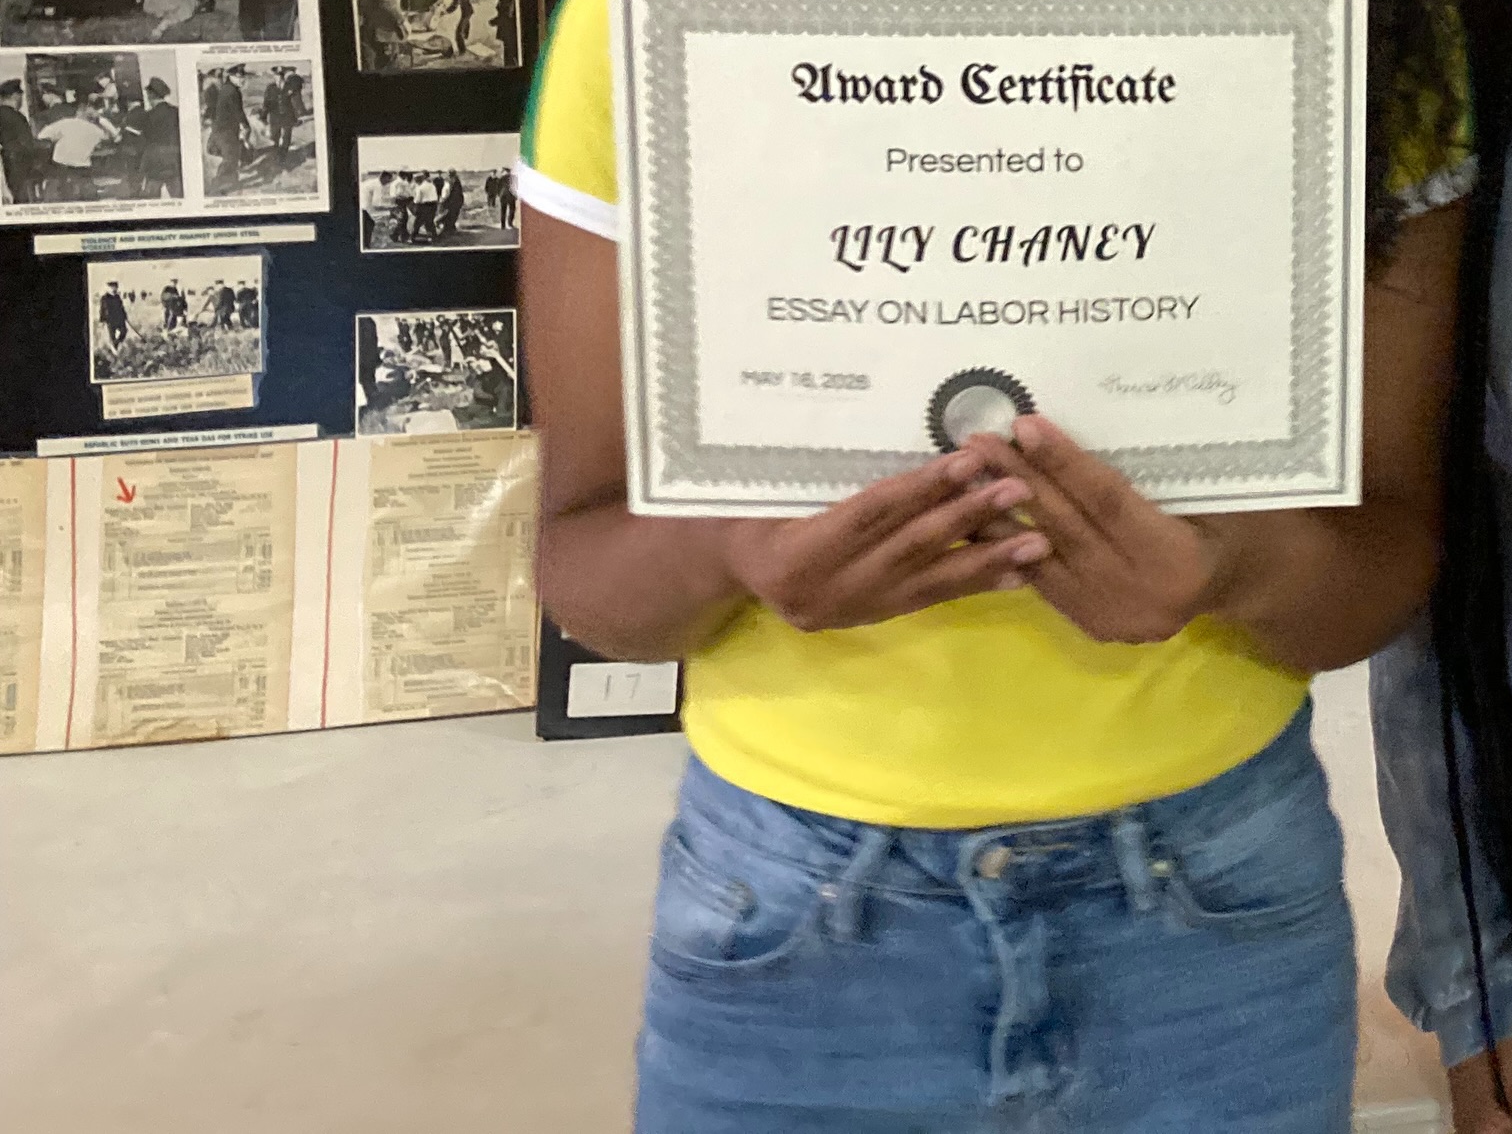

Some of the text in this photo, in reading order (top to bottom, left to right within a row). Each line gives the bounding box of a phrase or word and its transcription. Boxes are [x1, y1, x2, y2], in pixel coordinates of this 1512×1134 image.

[790, 62, 1177, 113] Award Certificate
[886, 147, 1085, 174] Presented to
[830, 222, 1158, 273] LILY CHANEY
[767, 296, 1201, 326] ESSAY ON LABOR HISTORY
